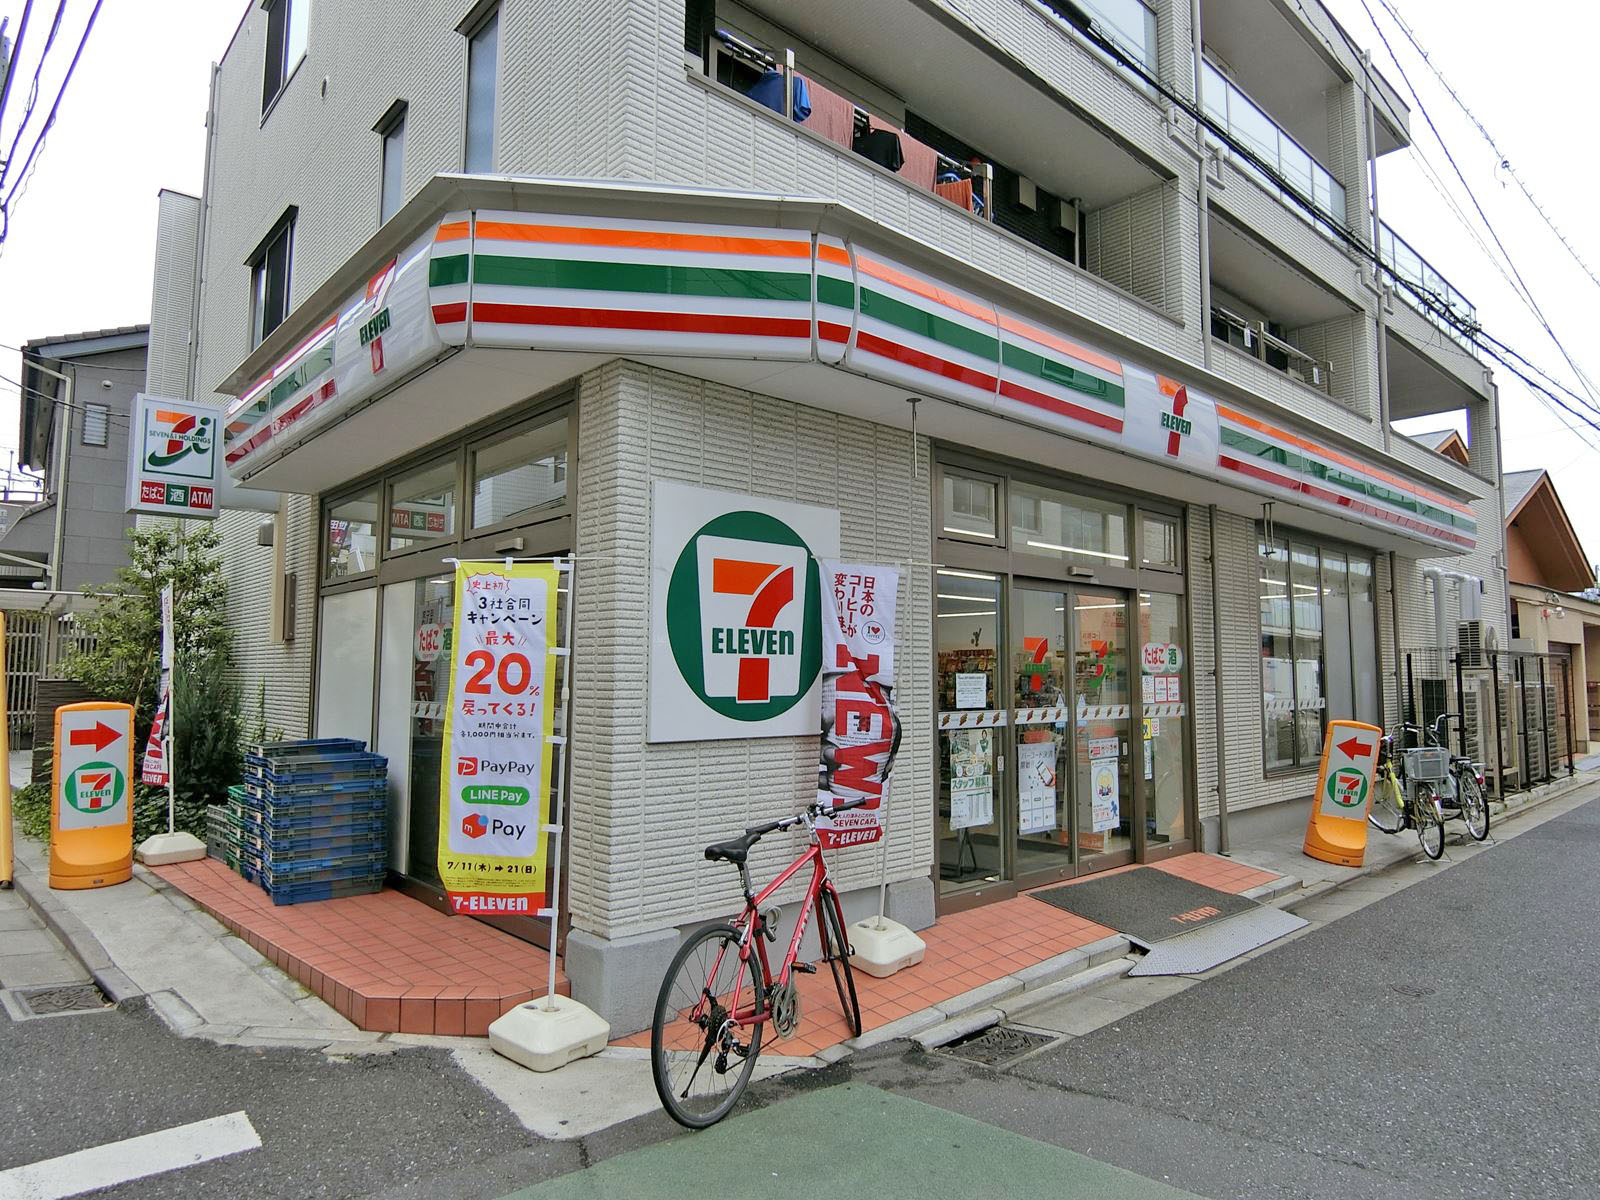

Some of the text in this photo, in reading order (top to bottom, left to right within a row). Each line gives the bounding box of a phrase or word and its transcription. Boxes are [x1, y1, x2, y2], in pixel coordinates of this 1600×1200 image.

[360, 307, 391, 347] ELEVEN
[1161, 412, 1192, 436] ELEVEN
[179, 435, 211, 445] HOLDINGS
[142, 486, 212, 506] たばこ 酒 ATM
[472, 580, 504, 591] 史上初
[478, 597, 531, 611] 3社合同
[834, 572, 848, 634] 変わりま
[860, 576, 876, 617] 日本の
[847, 574, 862, 639] コーヒーが
[467, 611, 543, 626] キャンペーン
[418, 628, 439, 652] たばこ
[485, 630, 515, 646] 最大
[712, 628, 794, 655] ELEVEN
[1144, 646, 1177, 665] たばこ 酒
[464, 649, 540, 696] 20%
[462, 699, 536, 717] 戻ってくる!
[481, 760, 535, 776] PayPay
[80, 789, 112, 798] ELEVEN
[470, 790, 523, 803] LINE Pay
[1337, 788, 1359, 797] ELEVEN
[492, 819, 526, 840] Pay
[833, 819, 859, 827] SEVEN
[827, 829, 877, 845] 7-ELEVEN
[452, 896, 528, 911] 7-ELEVEN
